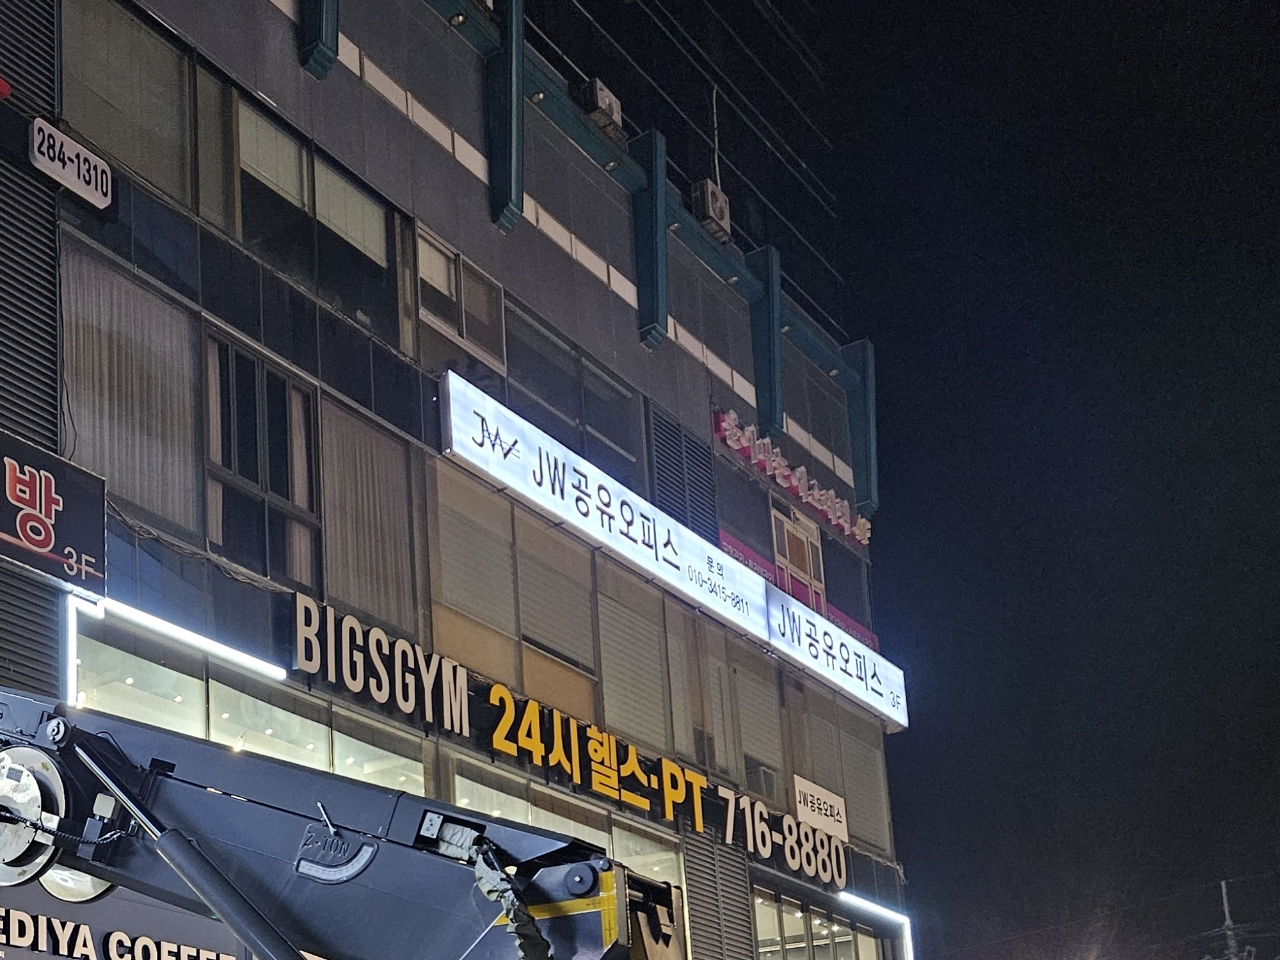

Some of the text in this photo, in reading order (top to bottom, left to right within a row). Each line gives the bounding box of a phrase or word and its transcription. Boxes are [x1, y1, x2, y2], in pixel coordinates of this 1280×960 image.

[35, 125, 110, 200] 284-1310
[532, 445, 681, 572] JW공유오피스
[63, 547, 97, 582] 3F
[777, 603, 884, 698] JW공유오피스
[890, 690, 902, 711] 3F
[295, 590, 470, 738] BIGSGYM
[489, 682, 582, 785] 24시
[718, 785, 847, 890] 716-8880
[798, 789, 843, 824] JW공유오피스
